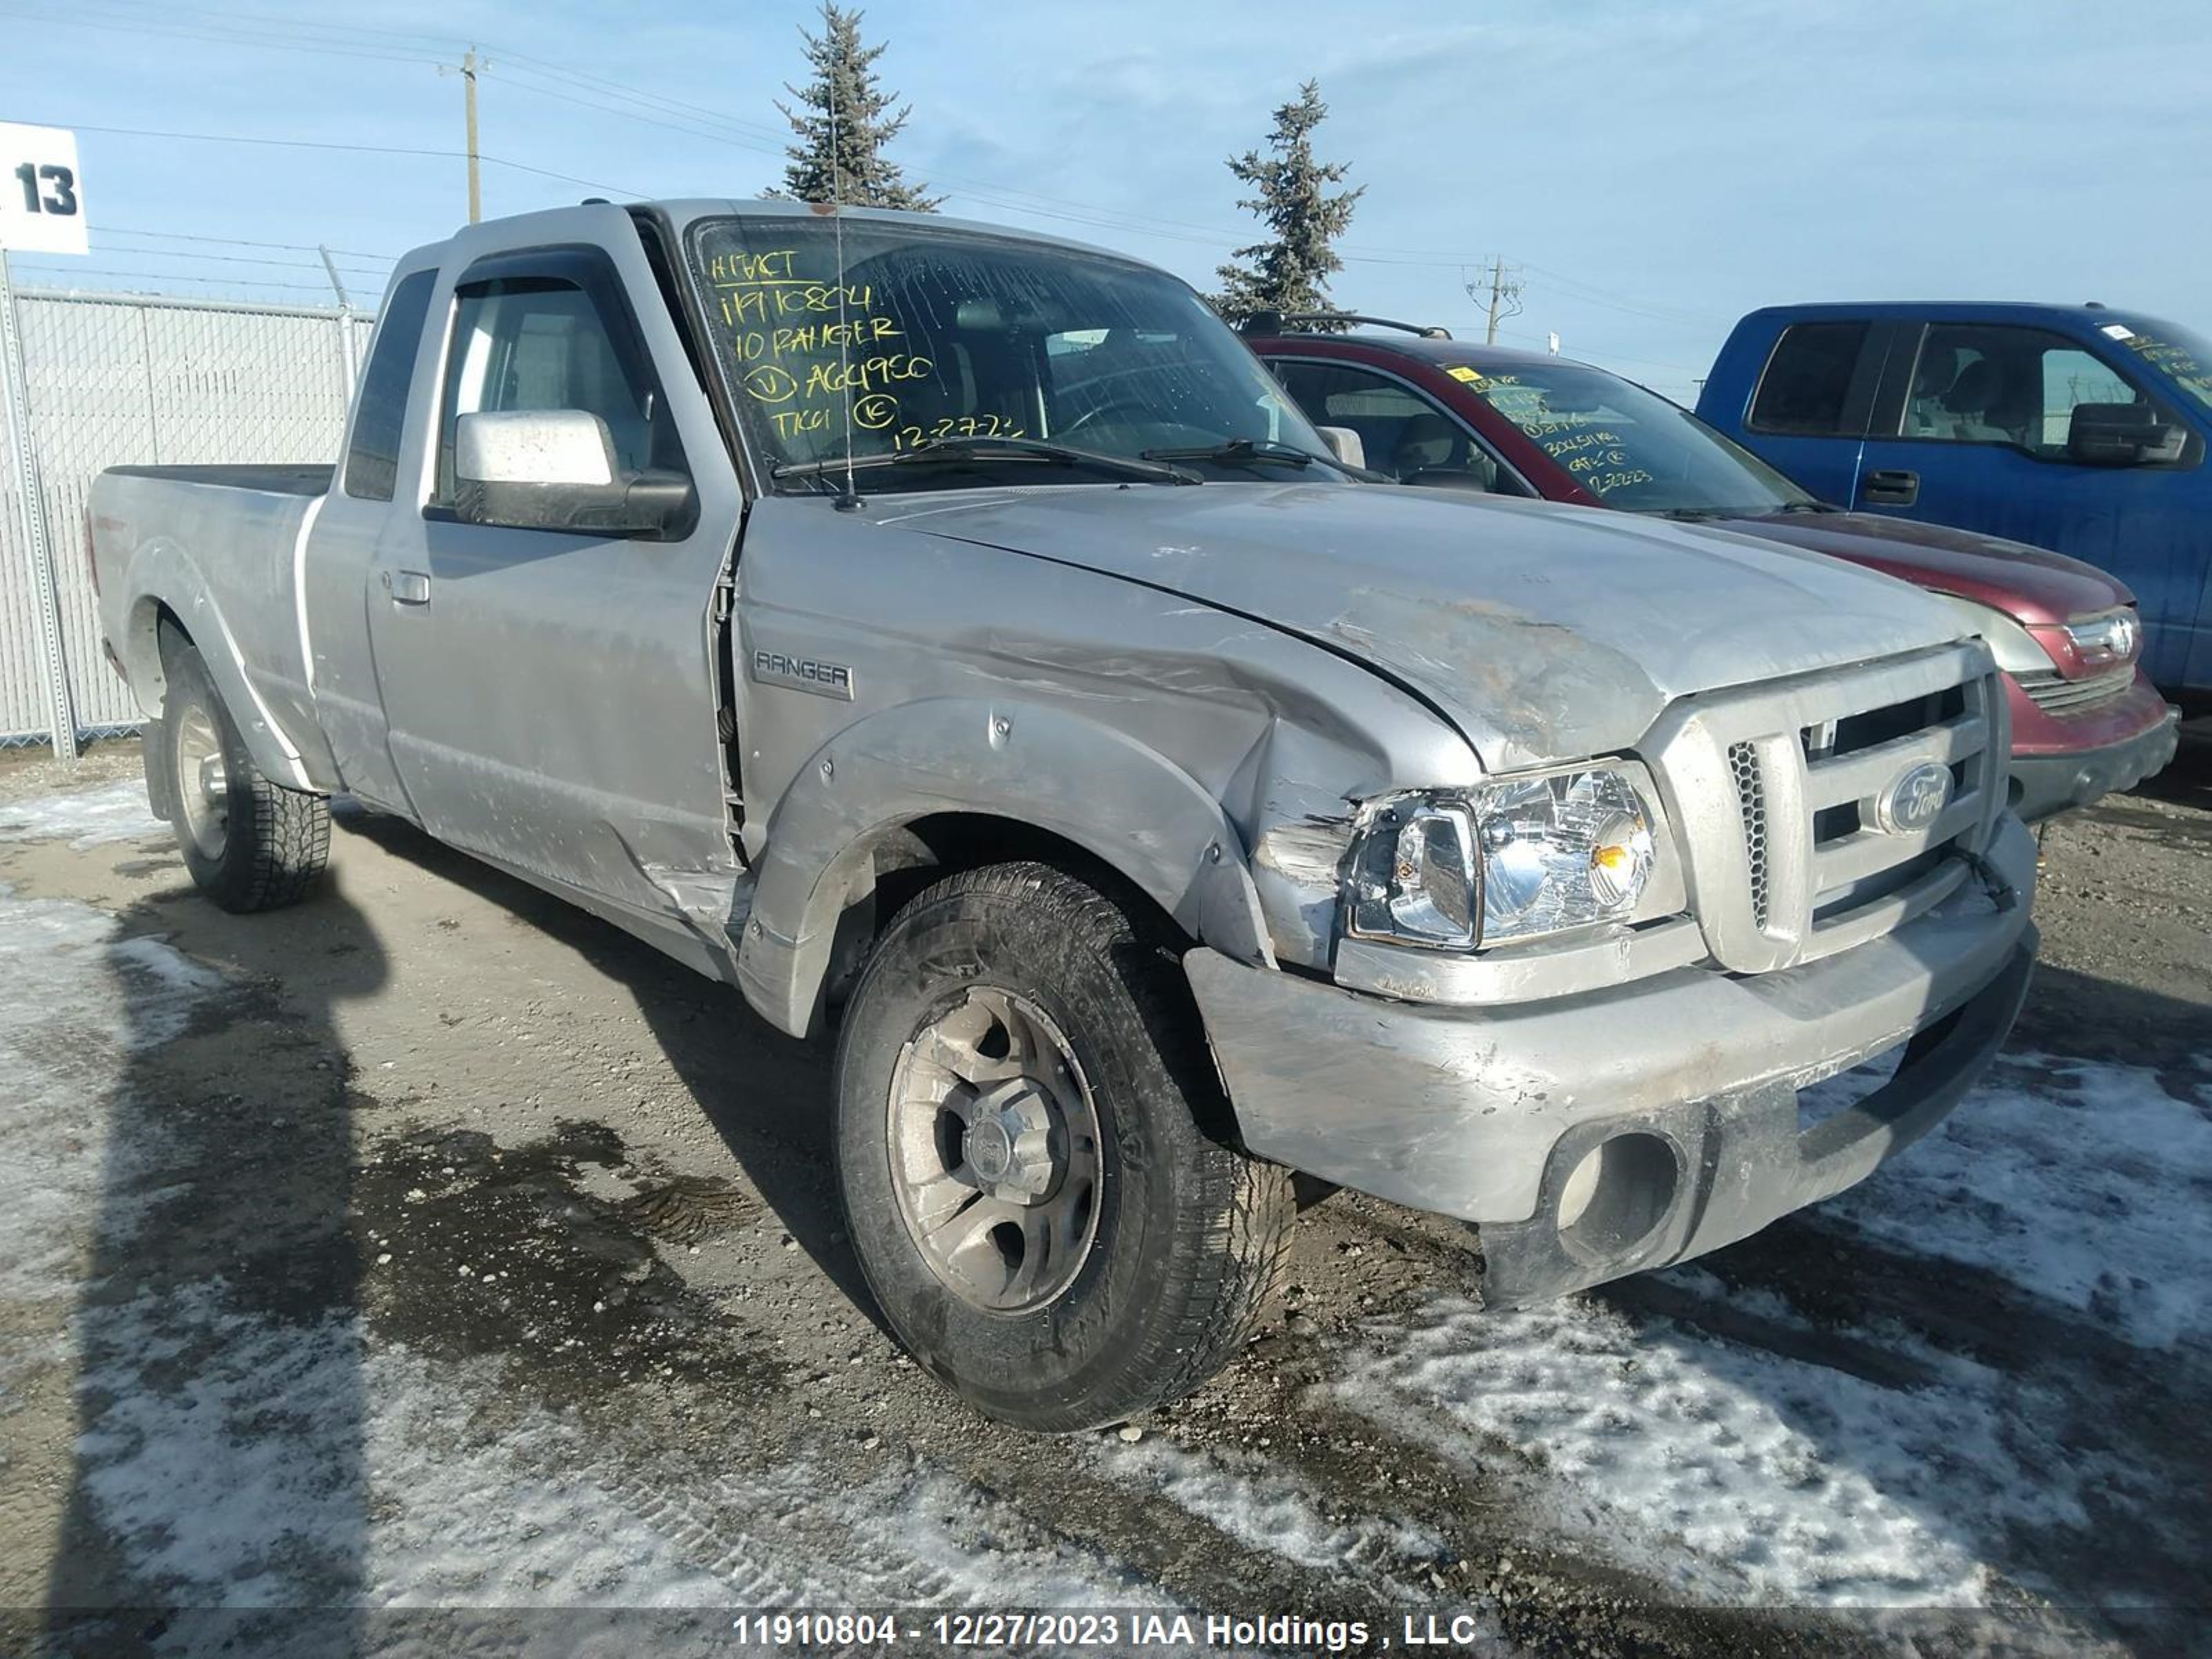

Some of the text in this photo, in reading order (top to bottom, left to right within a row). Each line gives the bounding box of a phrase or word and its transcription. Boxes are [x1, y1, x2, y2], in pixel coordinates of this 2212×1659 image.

[15, 162, 77, 216] 13
[735, 332, 765, 361] 10
[756, 651, 848, 687] RANGER
[1908, 774, 1947, 820] Ford
